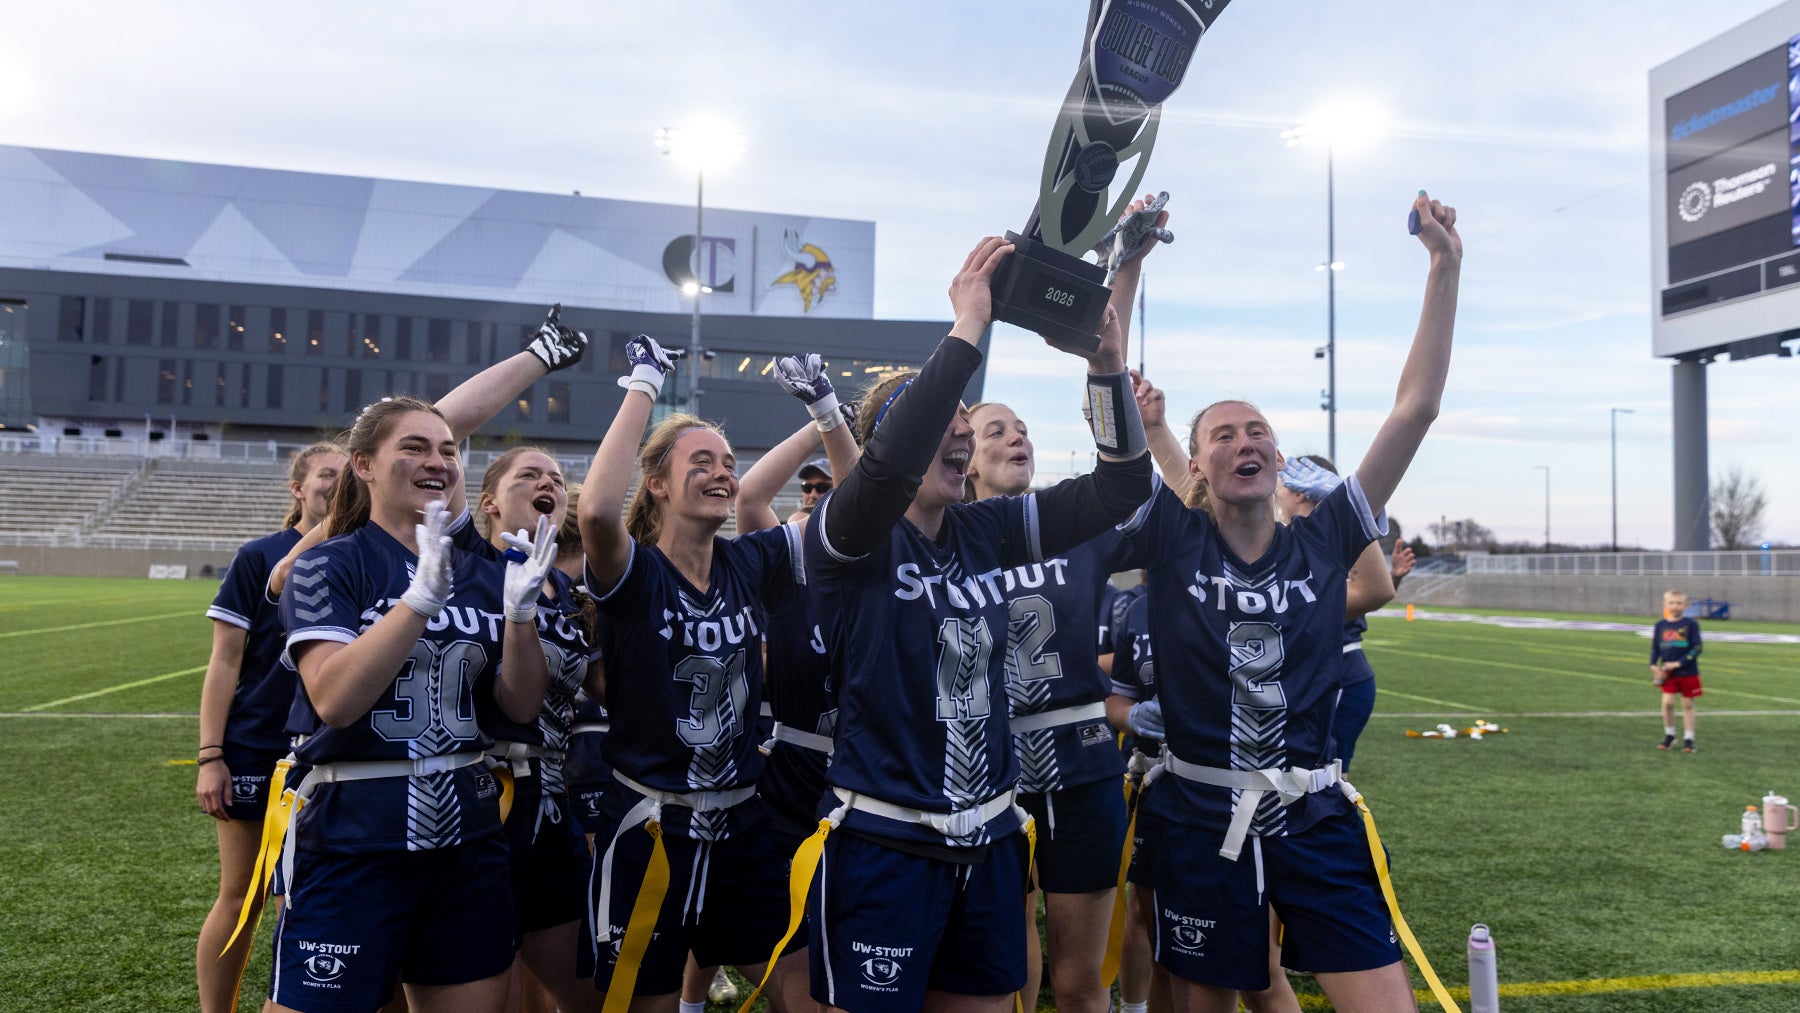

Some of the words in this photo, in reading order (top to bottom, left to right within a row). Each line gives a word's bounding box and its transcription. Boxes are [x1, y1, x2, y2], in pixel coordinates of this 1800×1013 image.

[1126, 0, 1159, 14] MIDWEST
[1159, 8, 1187, 37] WOMEN'S
[1101, 8, 1160, 70] COLLEGE
[1150, 34, 1189, 85] FLAG
[1119, 63, 1150, 85] LEAGUE
[1045, 286, 1075, 307] 2025
[894, 562, 1004, 610] STOUT
[1187, 569, 1317, 615] STOUT
[658, 604, 759, 651] STOUT
[935, 616, 993, 722] 11
[1226, 621, 1288, 709] 2
[371, 639, 488, 742] 30
[673, 647, 750, 748] 31
[1164, 908, 1217, 929] UW-STOUT
[299, 940, 361, 955] UW-STOUT
[852, 941, 914, 958] UW-STOUT
[302, 980, 326, 988] WOMEN'S
[860, 983, 885, 992] WOMEN'S
